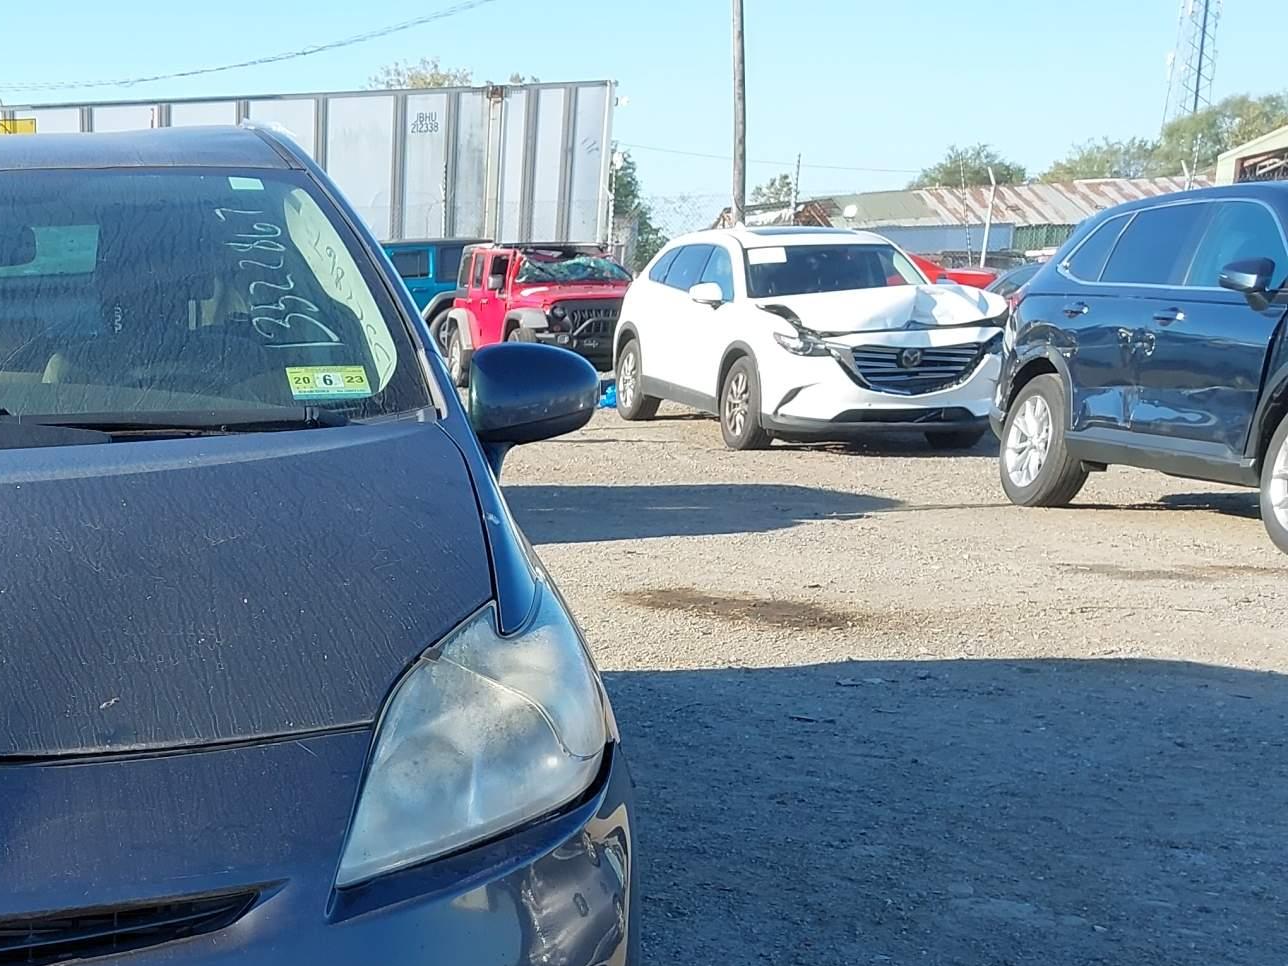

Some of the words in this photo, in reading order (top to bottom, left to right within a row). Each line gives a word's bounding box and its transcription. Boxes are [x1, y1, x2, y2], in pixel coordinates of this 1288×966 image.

[415, 111, 437, 122] JBHU
[411, 122, 439, 133] 212338
[293, 376, 311, 385] 20
[322, 374, 333, 386] 6
[345, 375, 364, 384] 23
